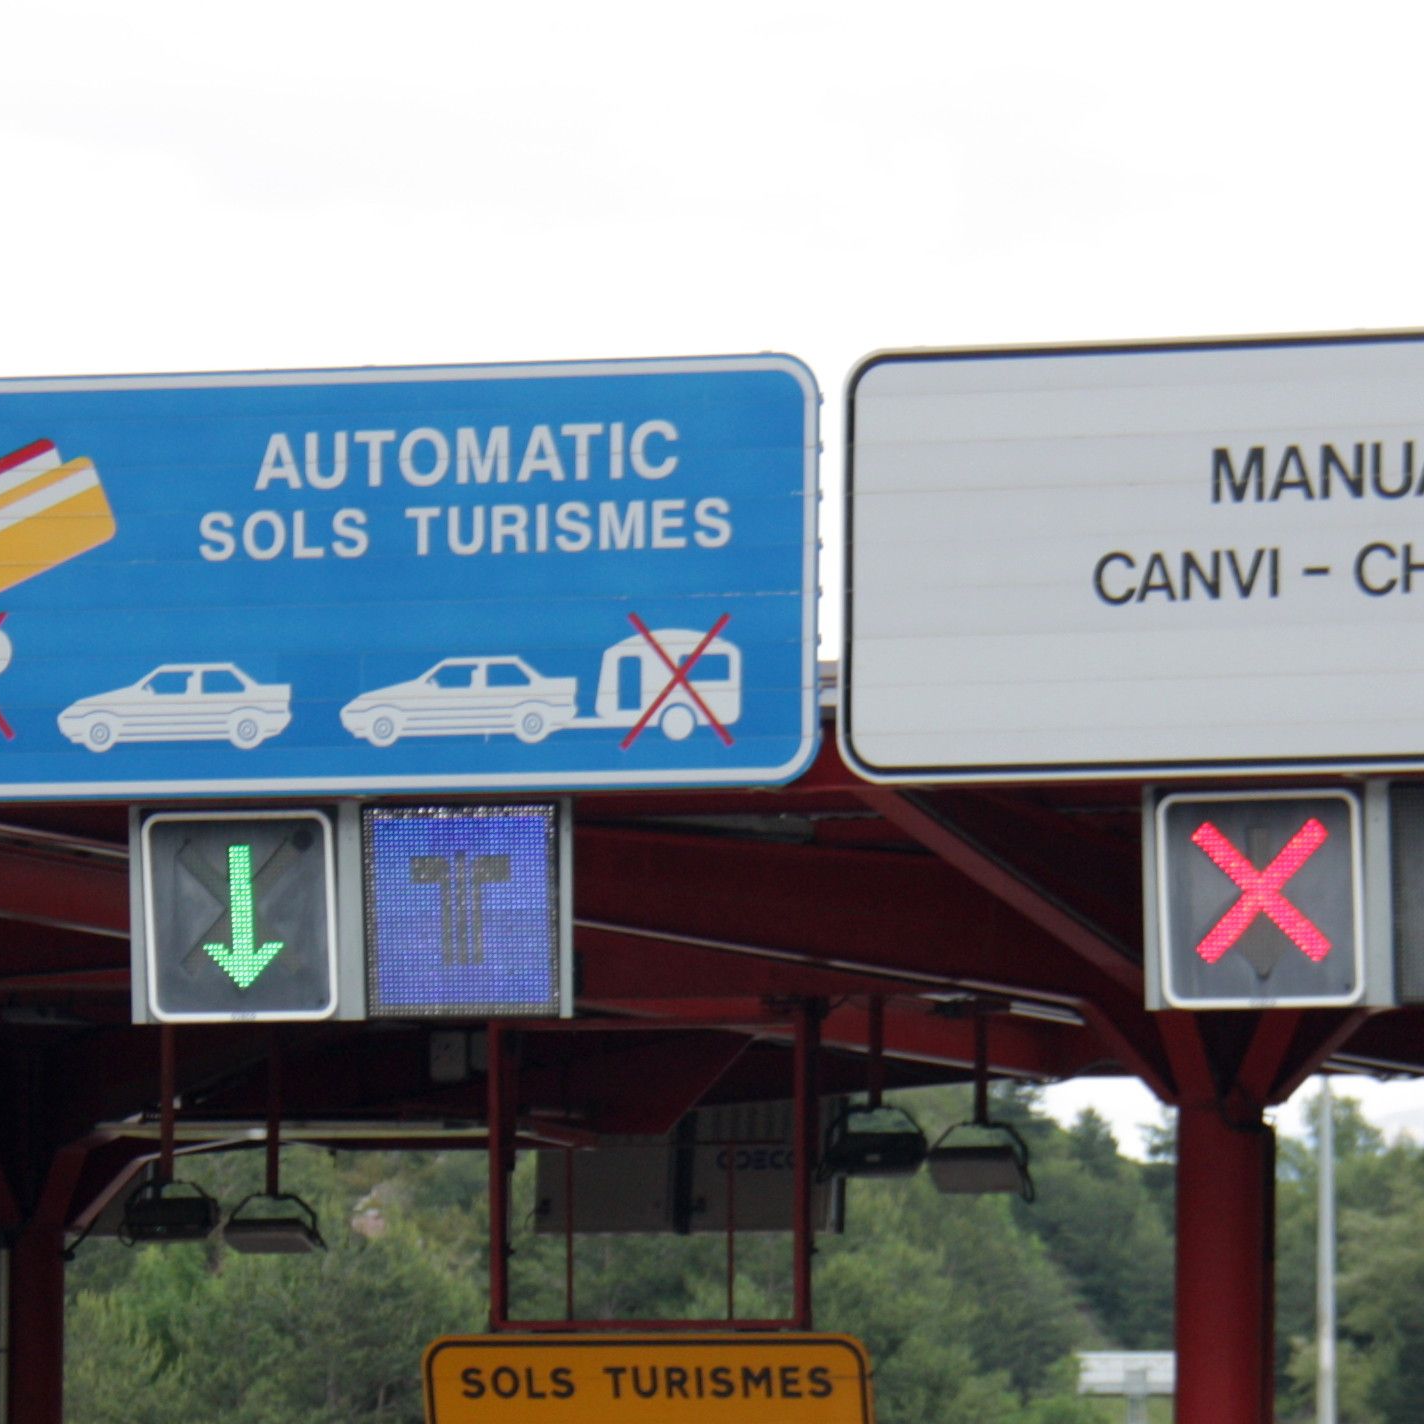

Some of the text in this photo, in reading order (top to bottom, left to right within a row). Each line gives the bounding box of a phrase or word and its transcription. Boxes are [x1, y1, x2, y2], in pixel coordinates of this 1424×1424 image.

[256, 420, 679, 491] AUTOMATIC
[200, 497, 732, 562] SOLS TURISMES
[1094, 547, 1280, 606] CANVI
[460, 1366, 835, 1401] SOLS TURISMES
